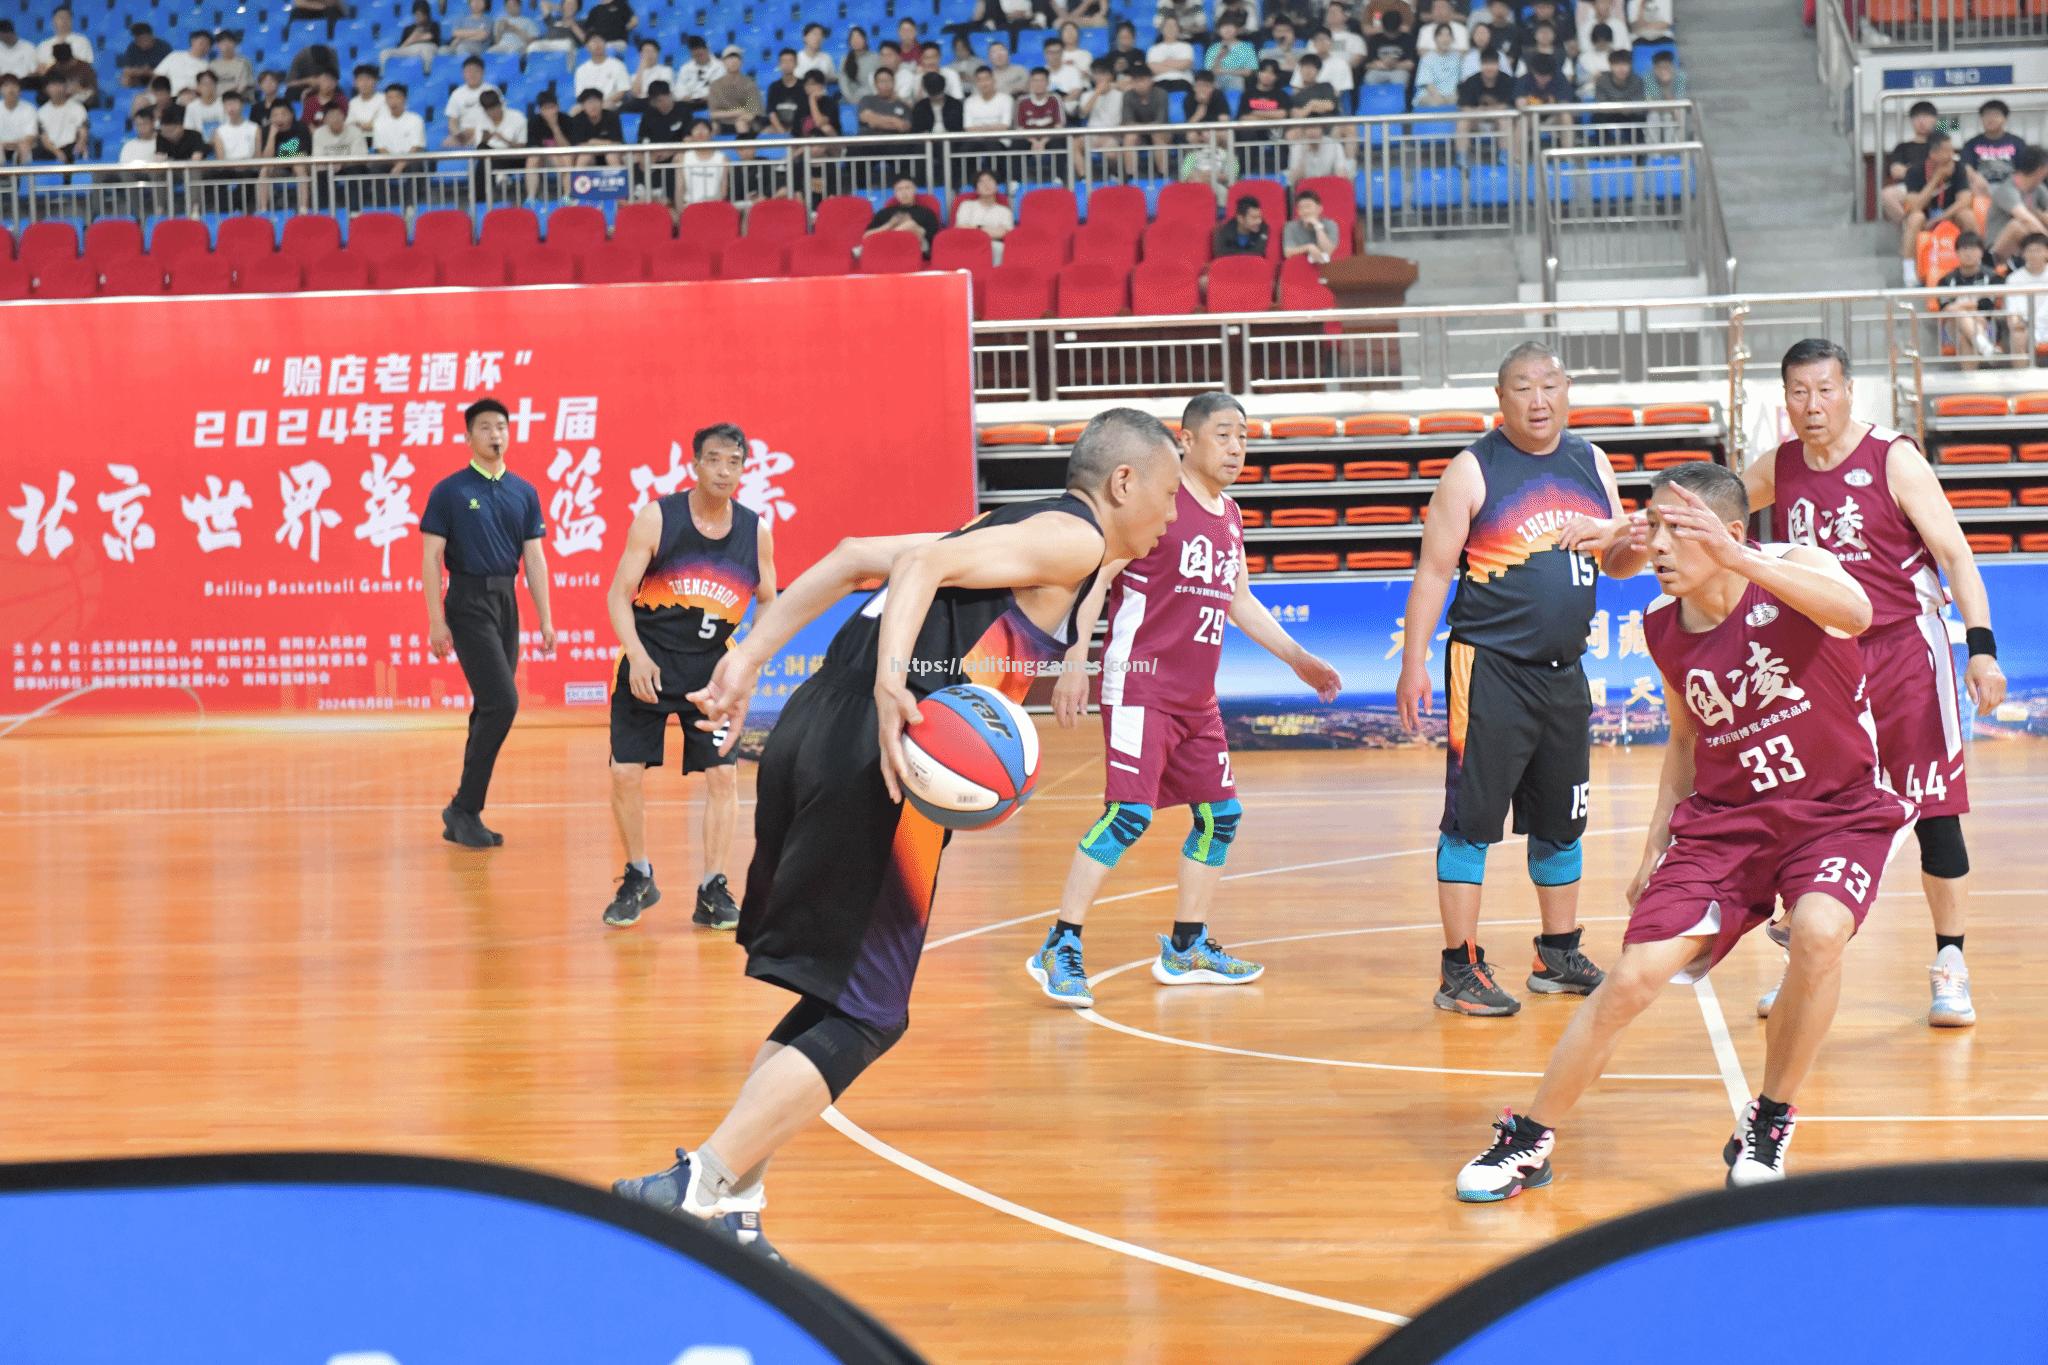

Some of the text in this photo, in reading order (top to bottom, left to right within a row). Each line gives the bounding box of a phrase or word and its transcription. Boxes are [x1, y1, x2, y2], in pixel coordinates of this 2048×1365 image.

[1568, 549, 1595, 587] 15
[669, 577, 740, 608] ZHENGZHOU
[698, 612, 721, 639] 5
[1193, 607, 1226, 645] 29
[1218, 752, 1235, 788] 2
[1739, 735, 1806, 793] 33
[1906, 761, 1947, 803] 44
[1571, 783, 1589, 820] 15
[1814, 857, 1871, 904] 33
